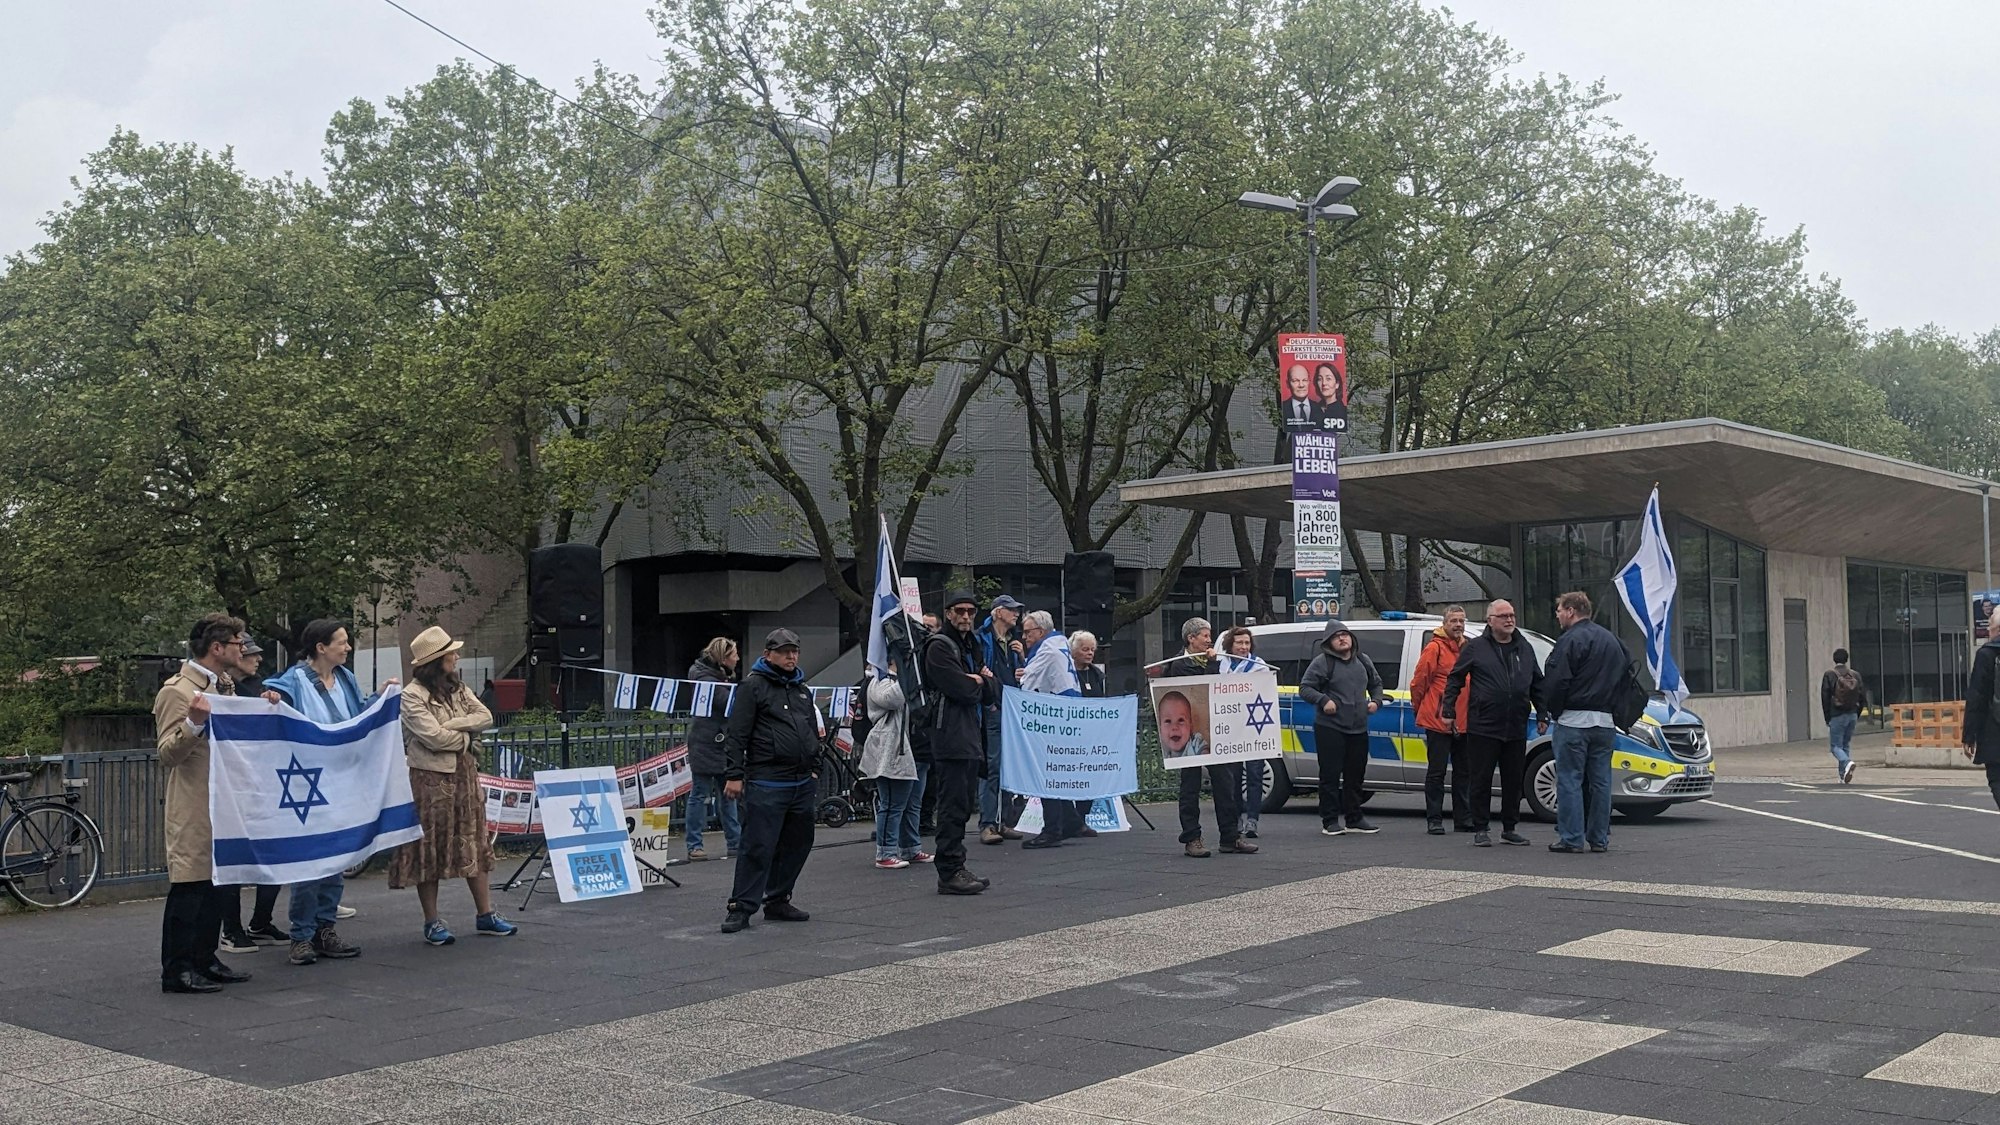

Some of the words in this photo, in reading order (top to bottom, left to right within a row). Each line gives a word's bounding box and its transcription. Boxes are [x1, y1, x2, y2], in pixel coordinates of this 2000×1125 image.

[1324, 418, 1345, 429] SPD
[1295, 434, 1336, 448] WÄHLEN
[1295, 446, 1336, 460] RETTET
[1295, 459, 1336, 475] LEBEN
[1299, 510, 1310, 521] in
[1315, 510, 1336, 522] 800
[1297, 520, 1338, 532] Jahren
[1298, 532, 1339, 544] leben?
[1214, 682, 1253, 694] Hamas:
[1020, 700, 1064, 718] Schützt
[1066, 705, 1119, 722] jüdisches
[1214, 702, 1242, 715] Lasst
[1020, 718, 1056, 734] Leben
[1059, 726, 1082, 736] vor:
[1214, 722, 1230, 734] die
[1046, 744, 1089, 756] Neonazis,
[1214, 740, 1252, 756] Geiseln
[1254, 738, 1276, 752] frei!
[1046, 762, 1122, 772] Hamas-Freunden,
[1046, 779, 1090, 789] Islamisten
[574, 854, 607, 866] FREE
[577, 864, 612, 875] GAZA
[578, 872, 615, 884] FROM
[580, 880, 624, 894] HAMAS
